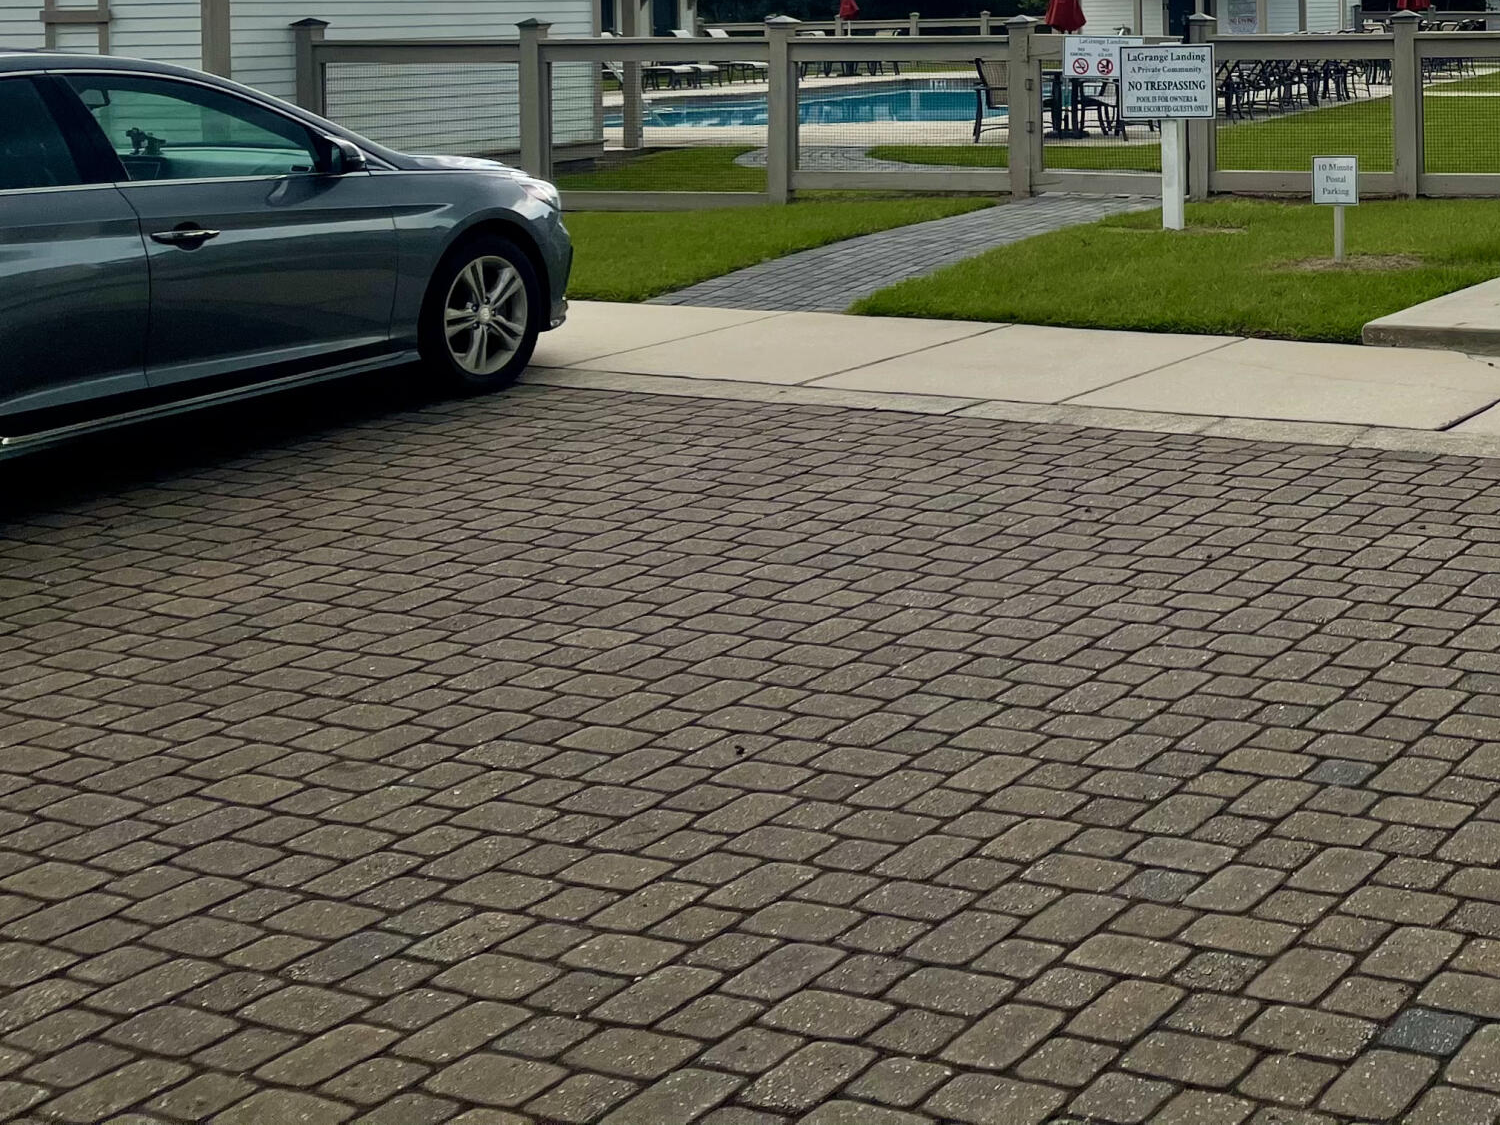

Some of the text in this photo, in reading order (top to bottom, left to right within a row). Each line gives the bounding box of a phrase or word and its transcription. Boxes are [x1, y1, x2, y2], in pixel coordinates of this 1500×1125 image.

[1127, 52, 1206, 63] LaGrange Landing
[1162, 66, 1201, 74] Community
[1128, 80, 1206, 91] NO TRESPASSING
[1328, 163, 1354, 171] Minute
[1325, 175, 1346, 183] Postal
[1322, 187, 1349, 197] Parking
